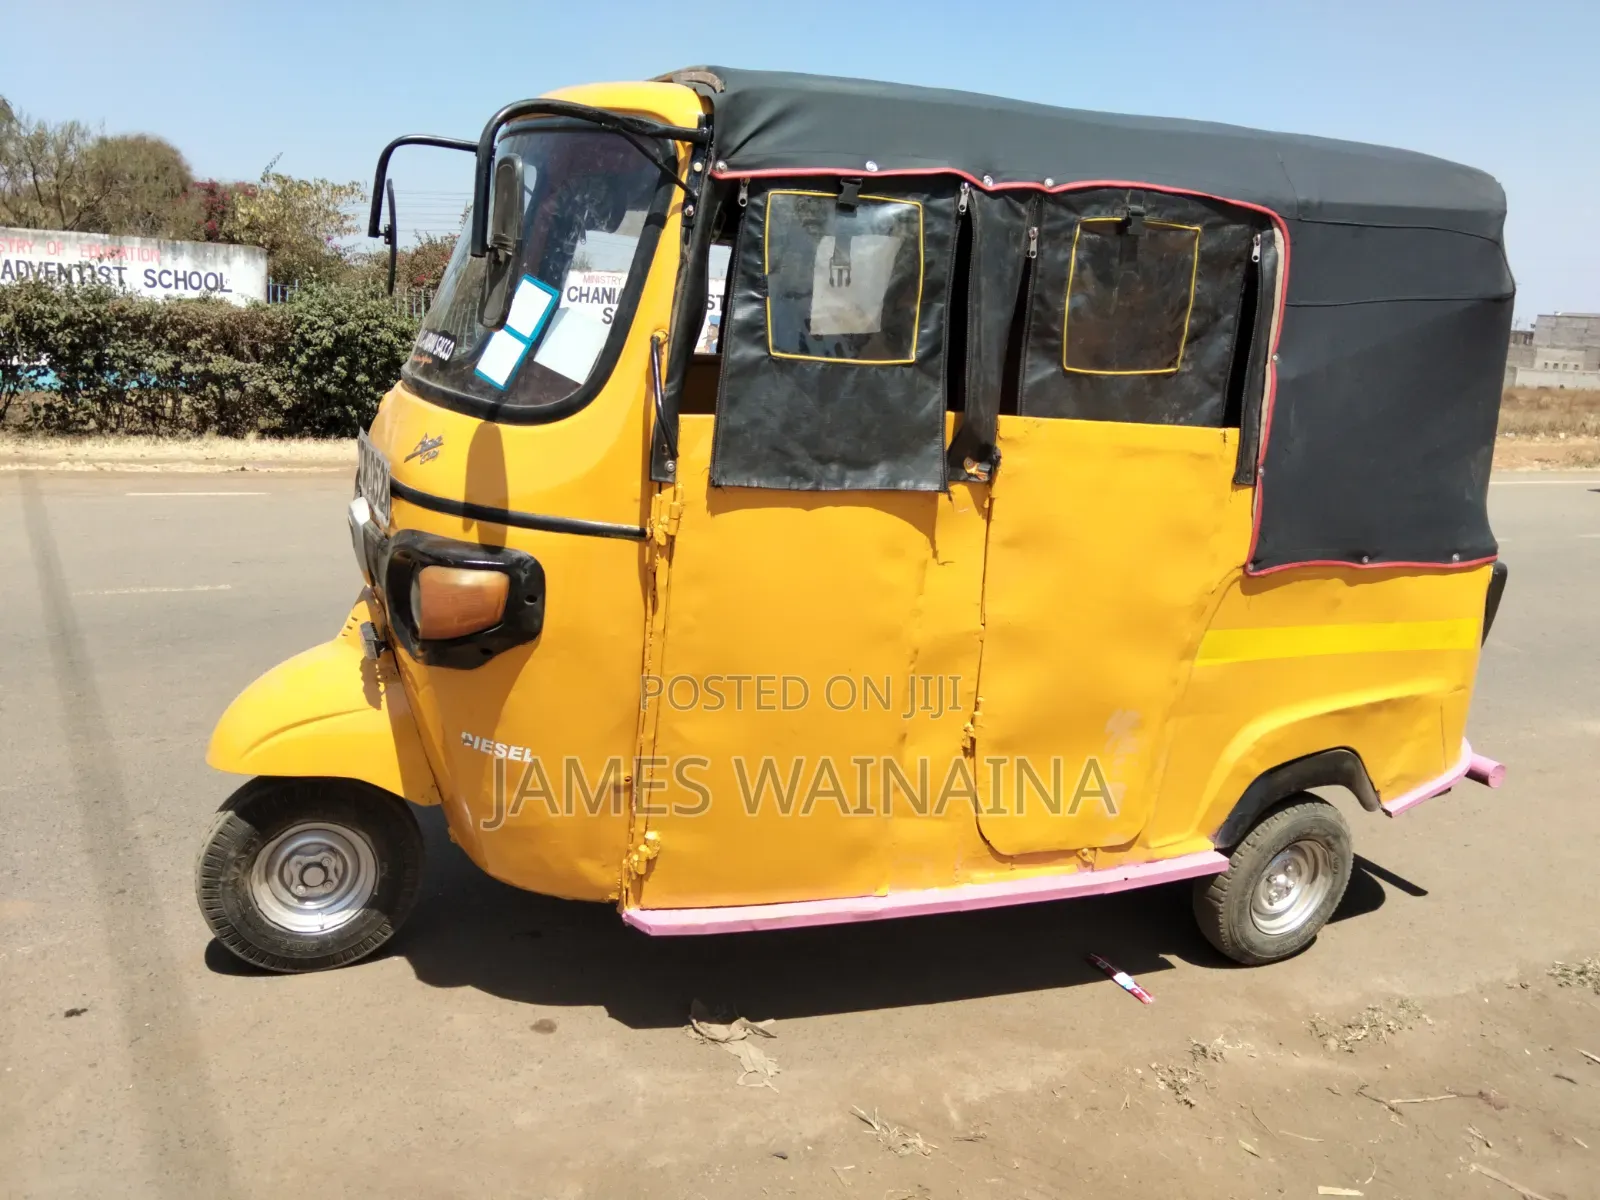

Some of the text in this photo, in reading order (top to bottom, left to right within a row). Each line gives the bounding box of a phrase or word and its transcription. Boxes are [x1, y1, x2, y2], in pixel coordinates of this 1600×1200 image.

[143, 269, 233, 293] SCHOOL
[583, 275, 622, 285] MINISTRY
[461, 731, 534, 763] DIESEL
